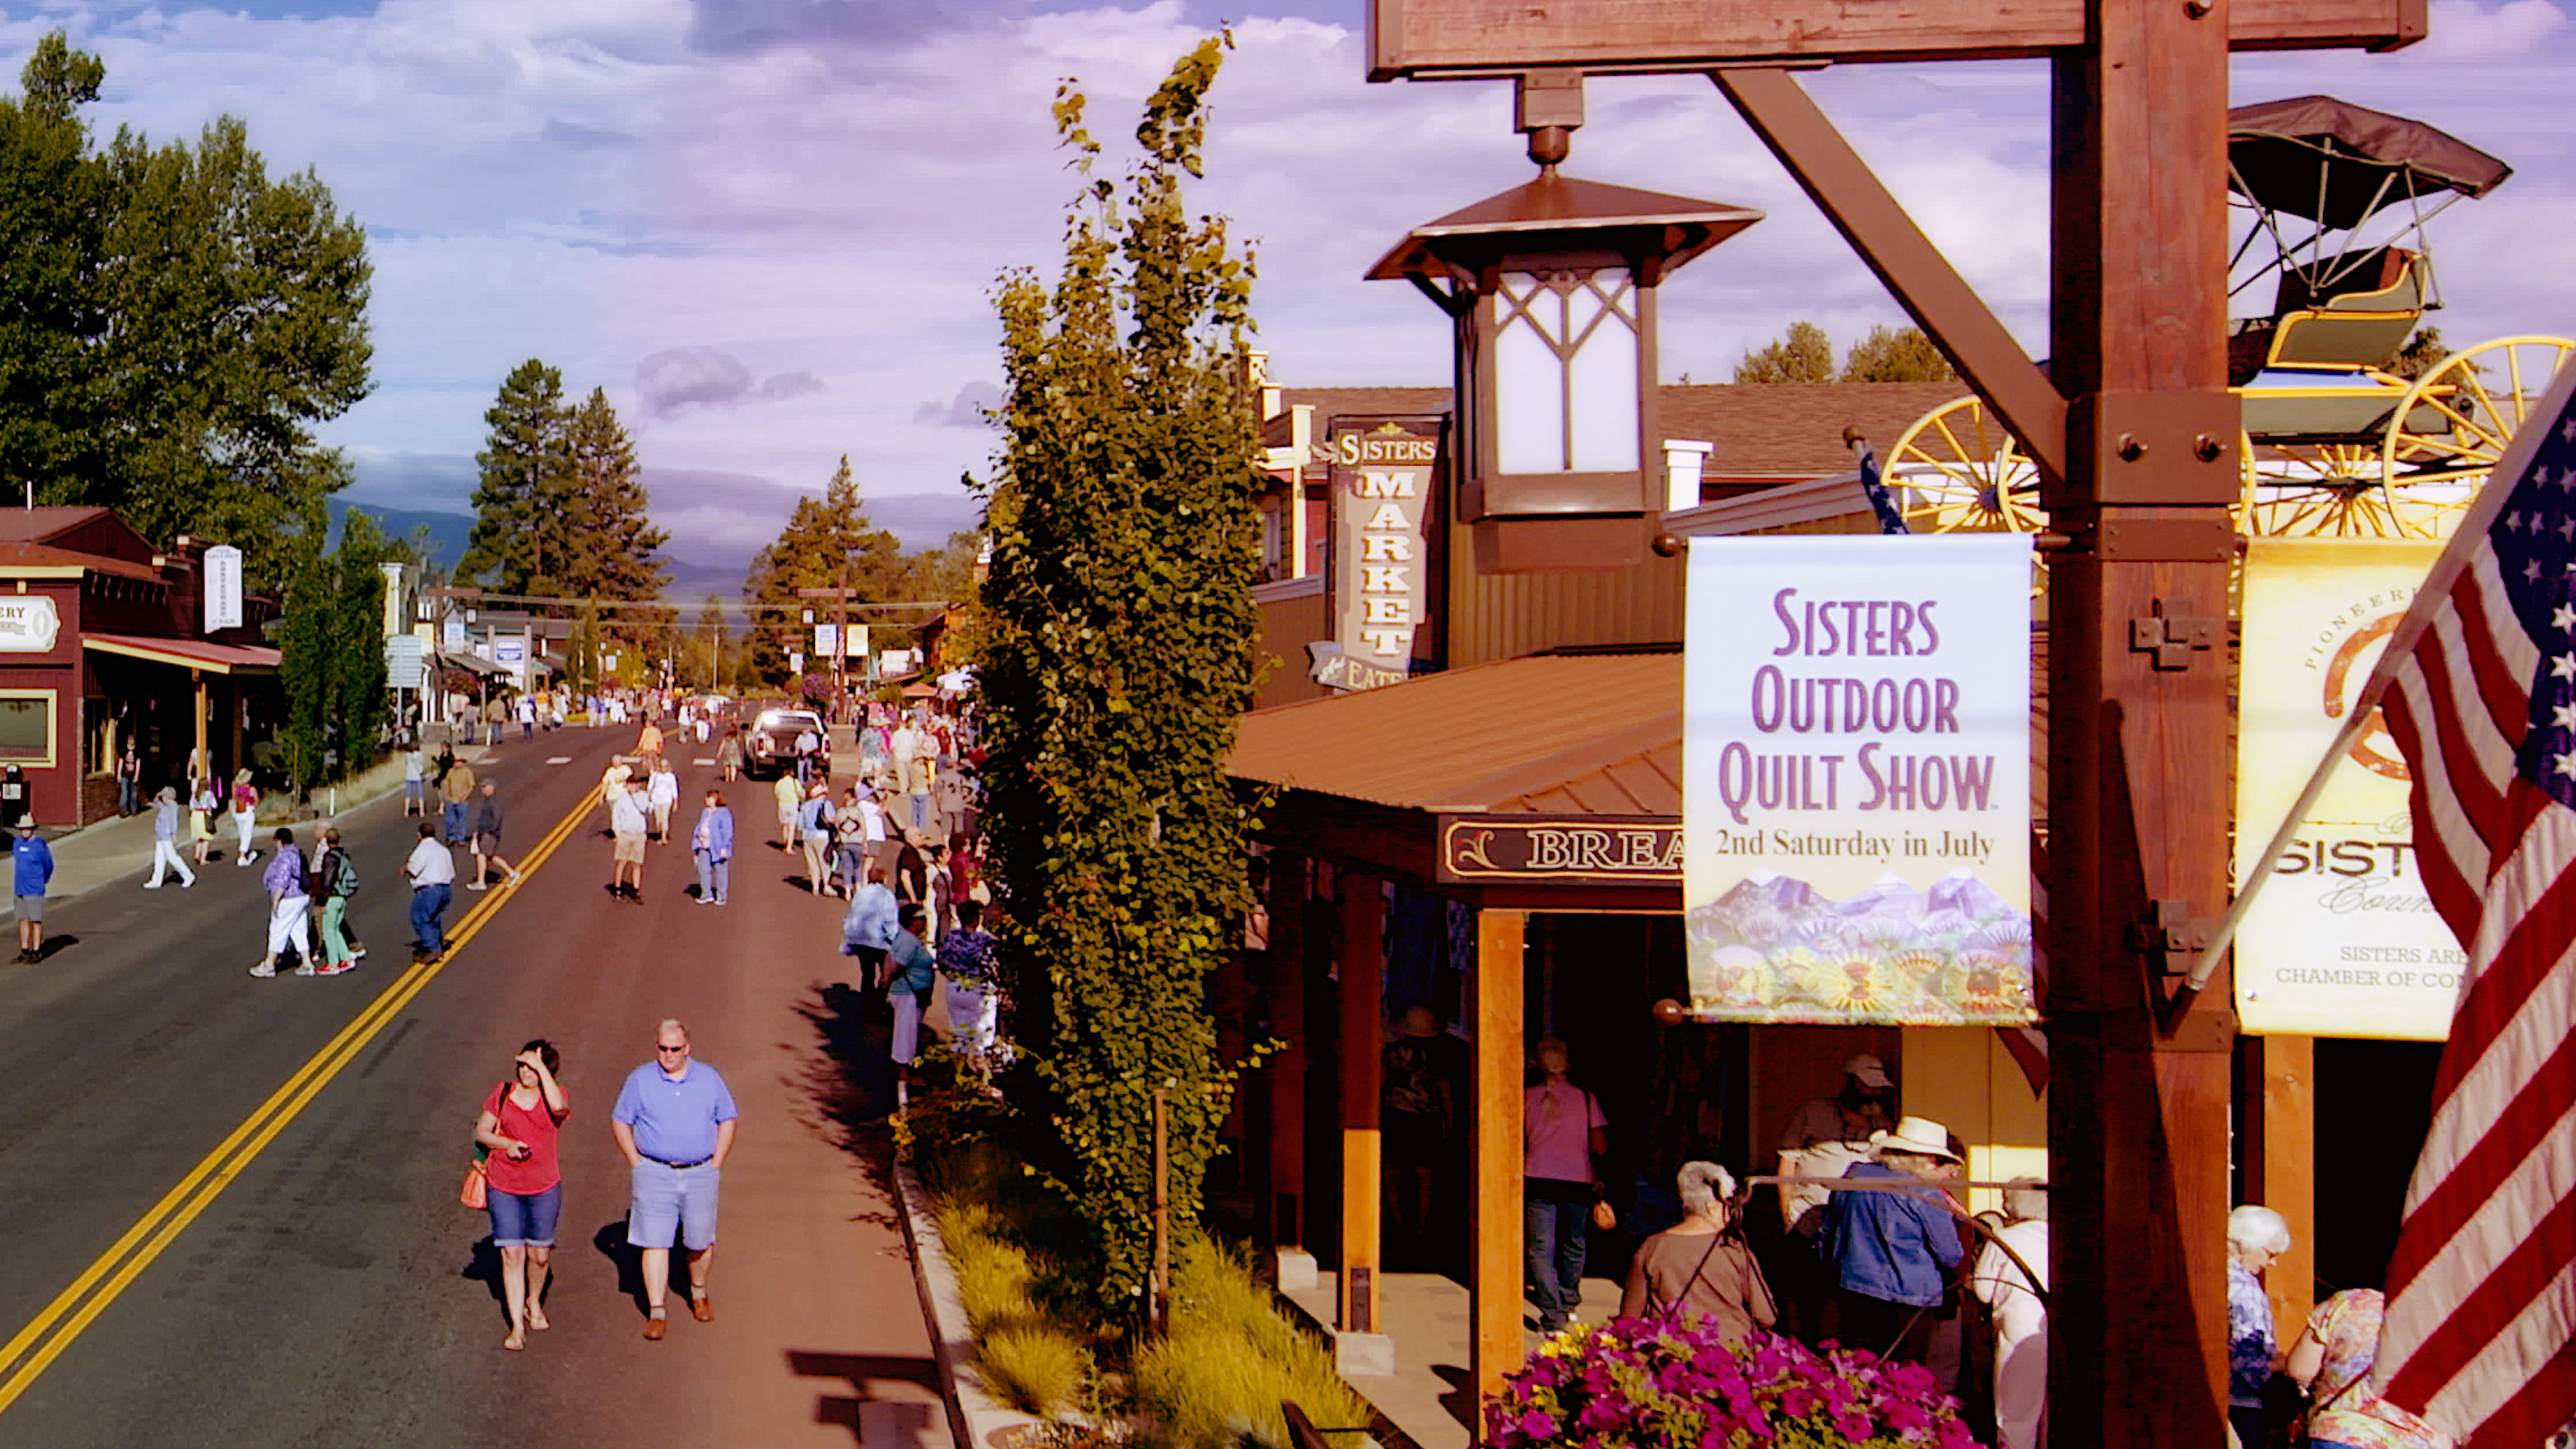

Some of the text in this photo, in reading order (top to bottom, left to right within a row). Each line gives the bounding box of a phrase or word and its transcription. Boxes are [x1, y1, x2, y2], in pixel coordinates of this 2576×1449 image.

[1340, 433, 1436, 465] SISTERS
[1362, 472, 1417, 657] MARKET
[1773, 587, 1939, 657] SISTERS
[1752, 663, 1960, 734] OUTDOOR
[1719, 741, 1996, 824] QUILT SHOW
[1717, 828, 1994, 864] 2nd Saturday in July
[2276, 967, 2381, 986] CHAMBER
[2387, 971, 2417, 987] OF
[2341, 946, 2421, 964] SISTERS
